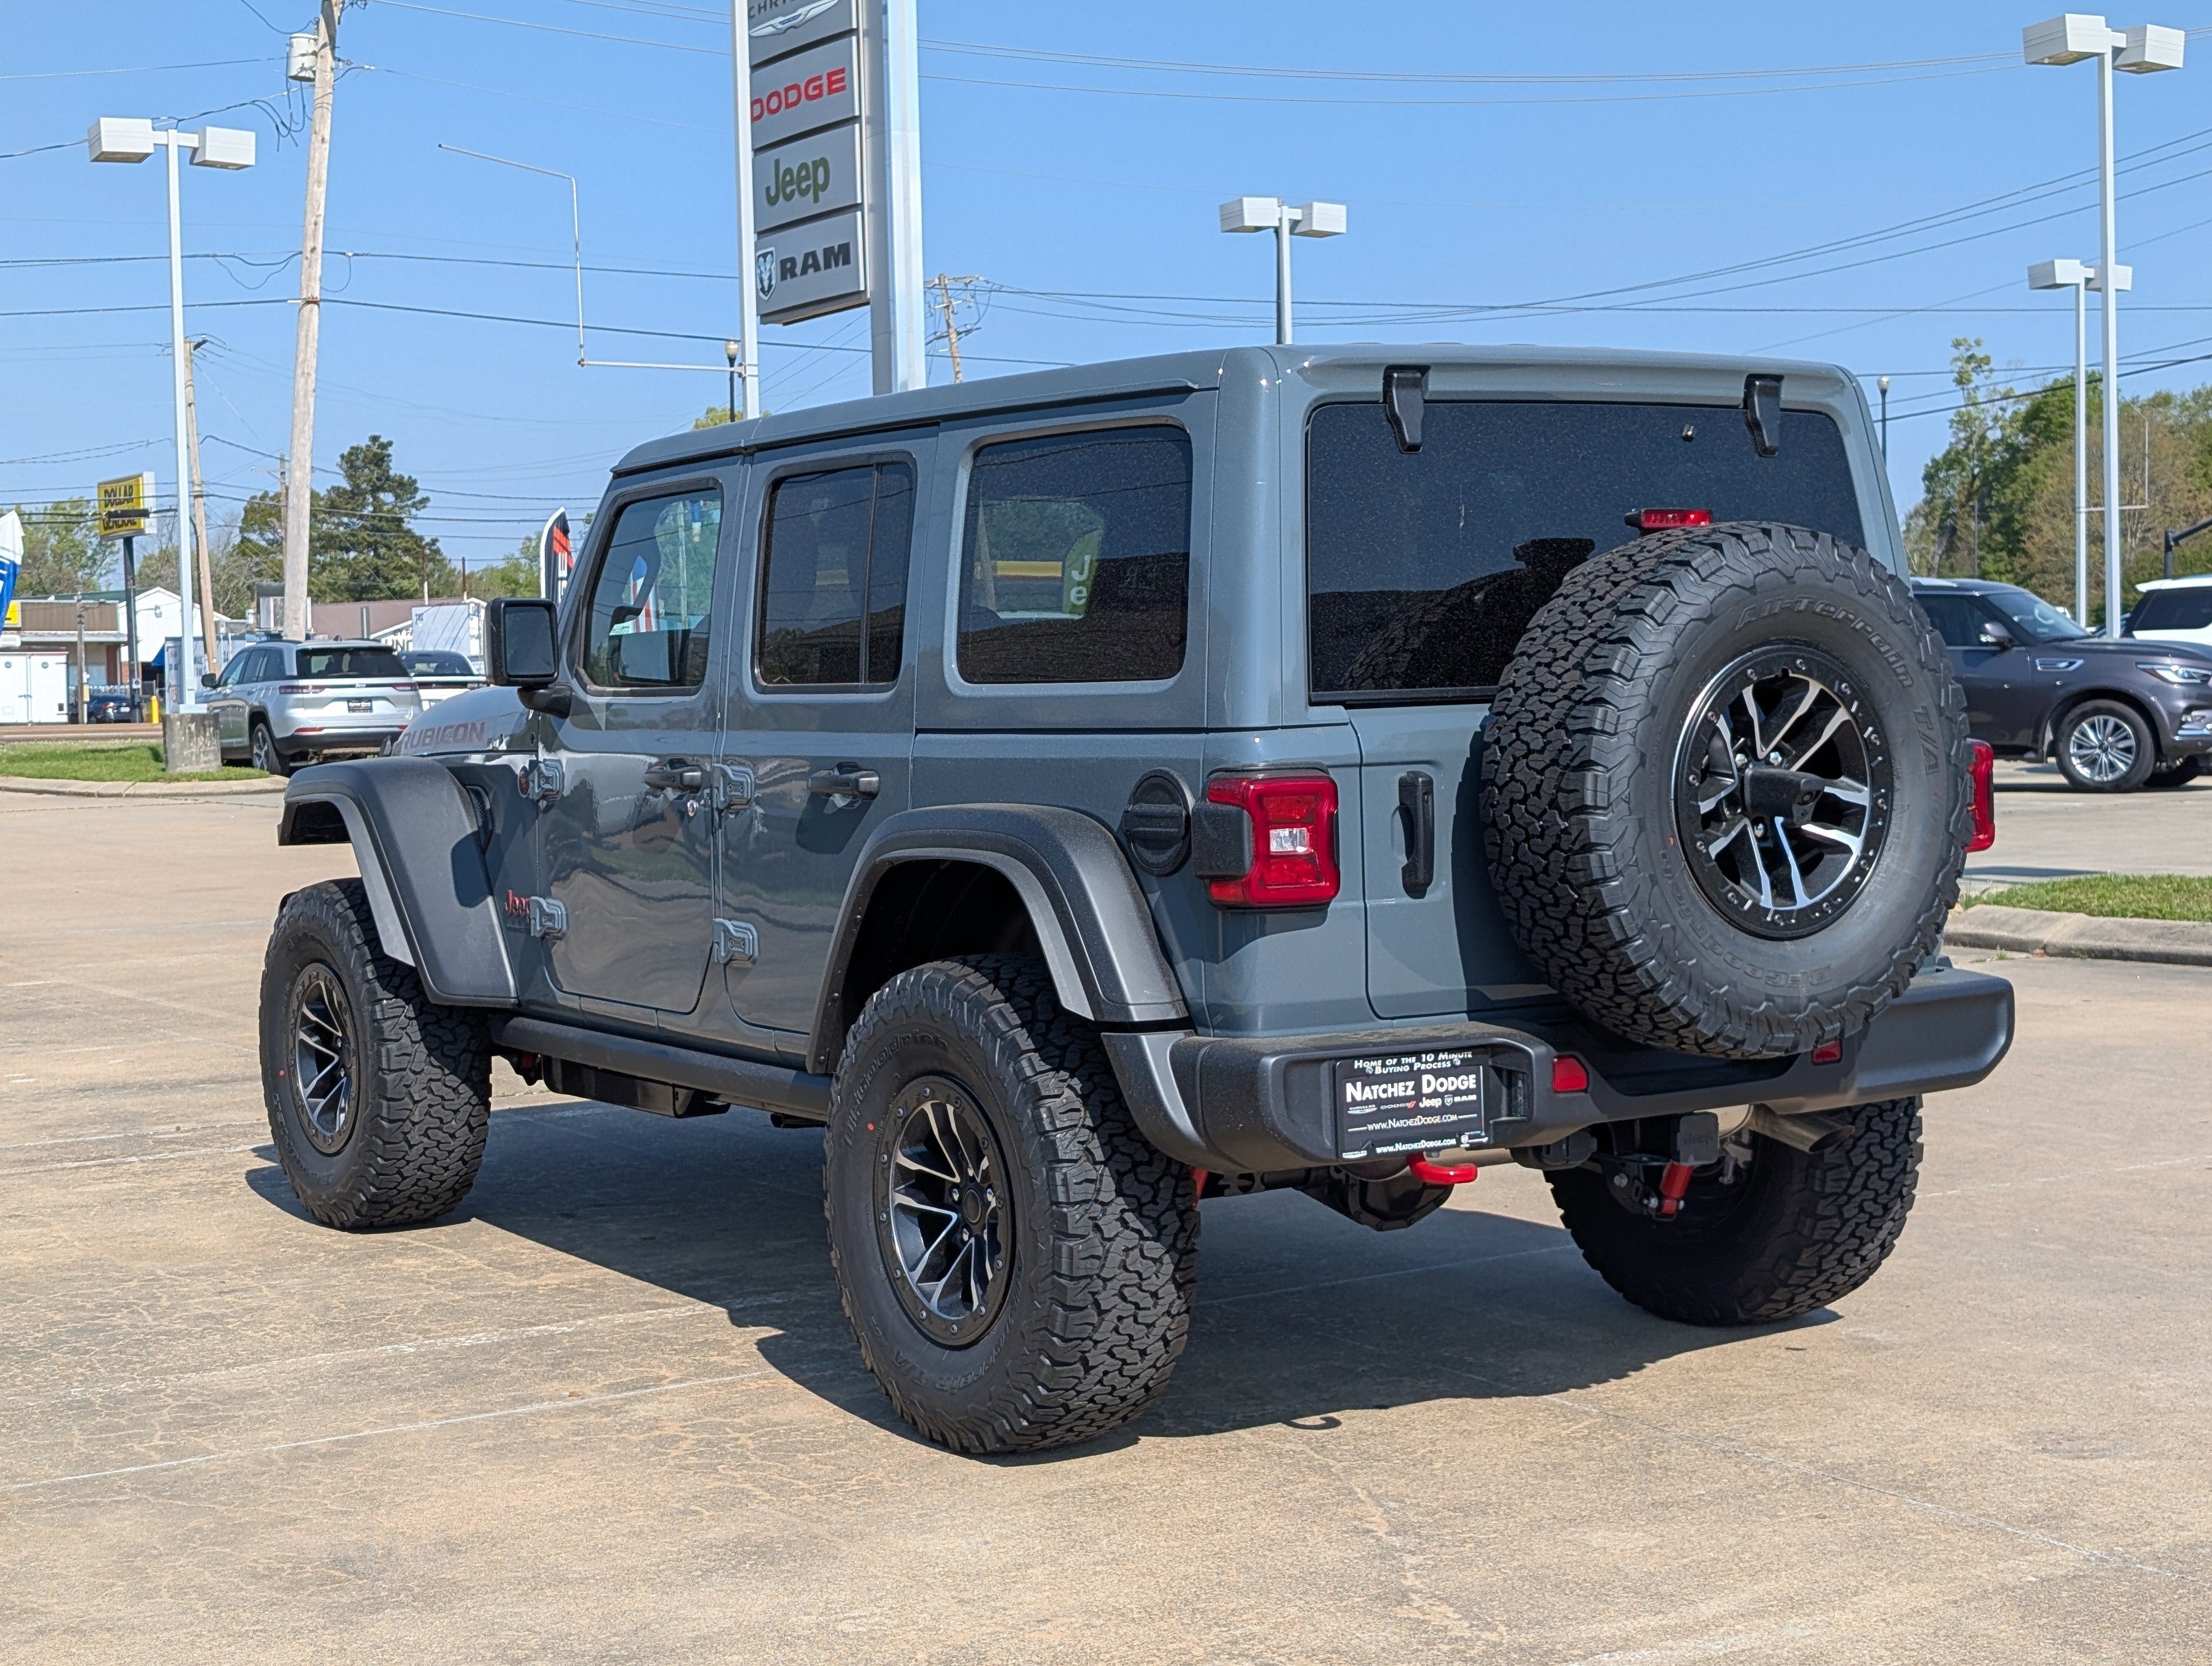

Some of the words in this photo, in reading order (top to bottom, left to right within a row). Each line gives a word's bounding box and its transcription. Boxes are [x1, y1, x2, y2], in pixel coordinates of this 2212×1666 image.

[750, 67, 847, 123] DODGE
[765, 157, 831, 207] Jeep
[780, 242, 851, 281] RAM
[104, 484, 134, 508] DOLLAR
[401, 720, 487, 749] RUBICON
[1354, 1059, 1382, 1069] HOME
[1422, 1053, 1435, 1062] 10
[1438, 1052, 1473, 1061] MINUTE
[1375, 1065, 1410, 1074] BUYING
[1413, 1061, 1451, 1071] PROCESS
[1346, 1081, 1415, 1103] NATCHEZ
[1422, 1074, 1477, 1094] DODGE
[1419, 1097, 1442, 1108] Jeep
